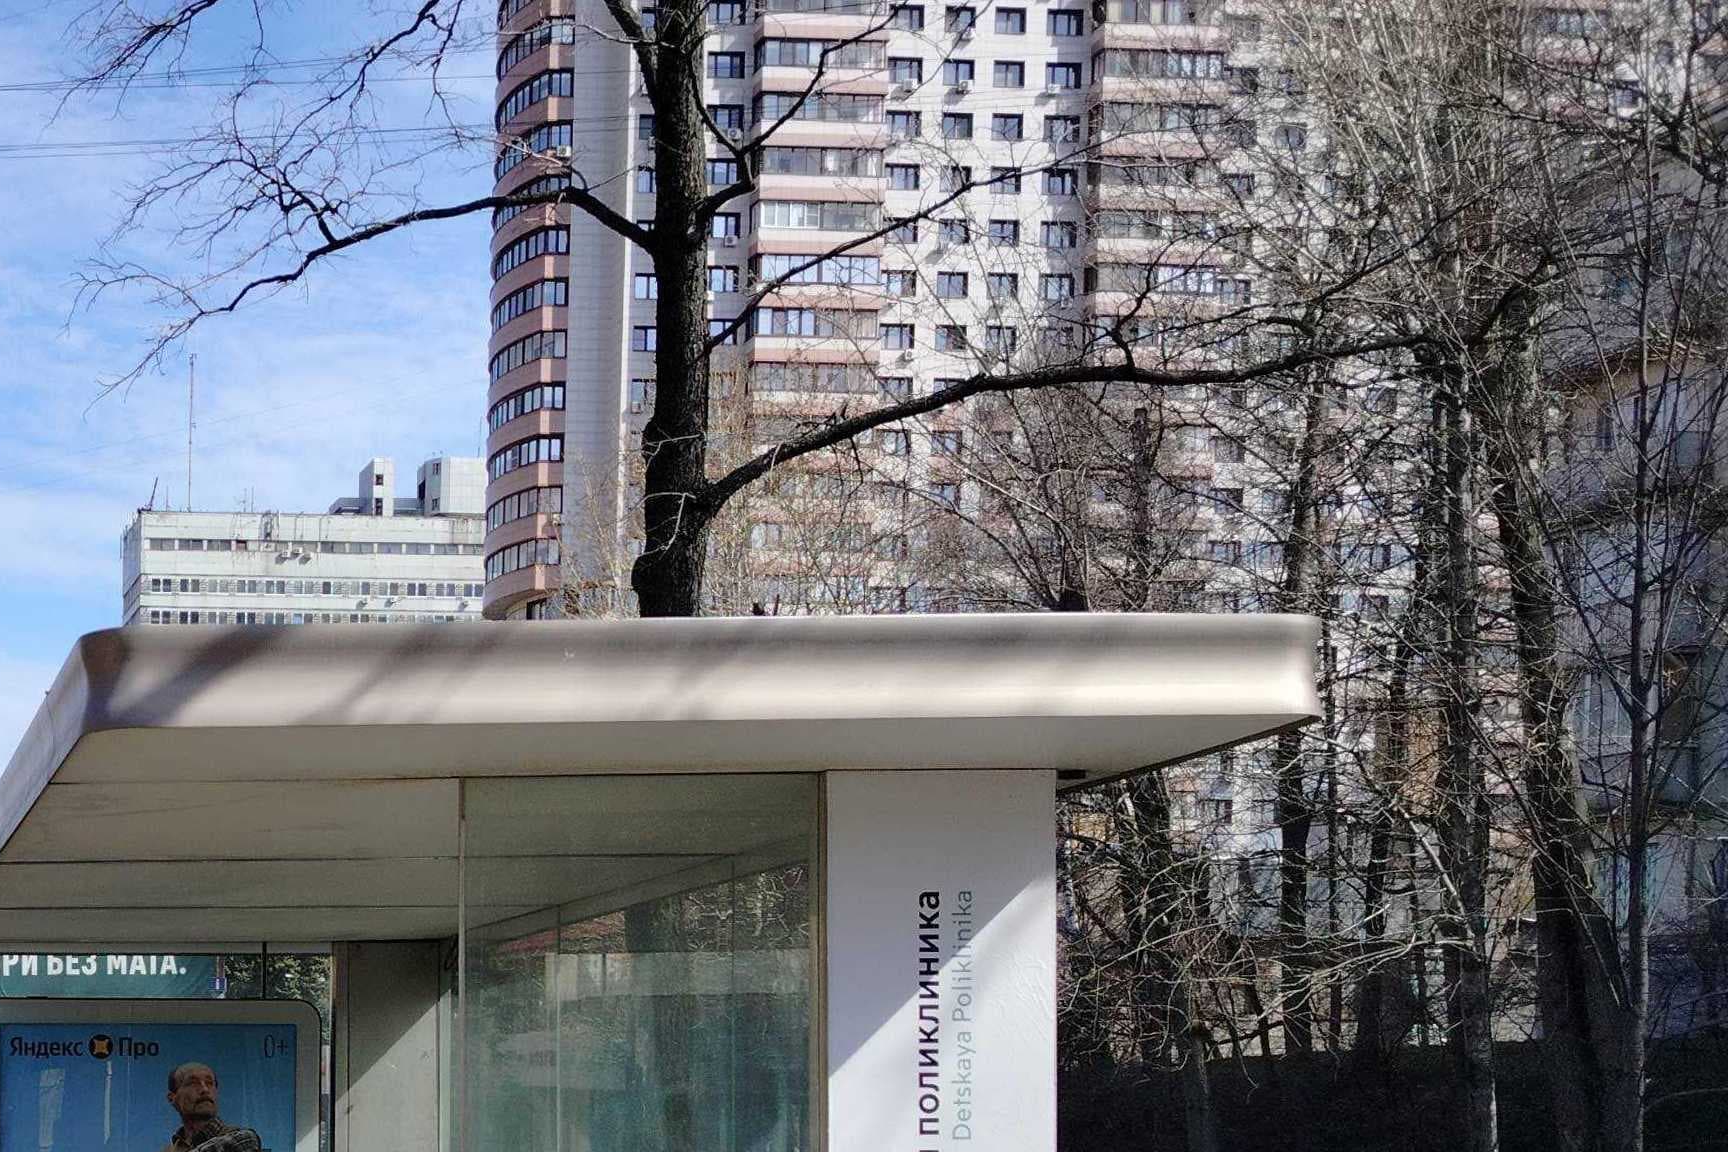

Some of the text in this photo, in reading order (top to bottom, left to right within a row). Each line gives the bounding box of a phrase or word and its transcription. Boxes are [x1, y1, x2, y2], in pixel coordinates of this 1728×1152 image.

[47, 955, 97, 976] БЕЗ
[918, 890, 941, 1136] поликлиника
[951, 890, 975, 1141] Detskaya Poliklinika
[10, 1037, 160, 1060] Яндекс Про
[264, 1034, 289, 1059] 0+
